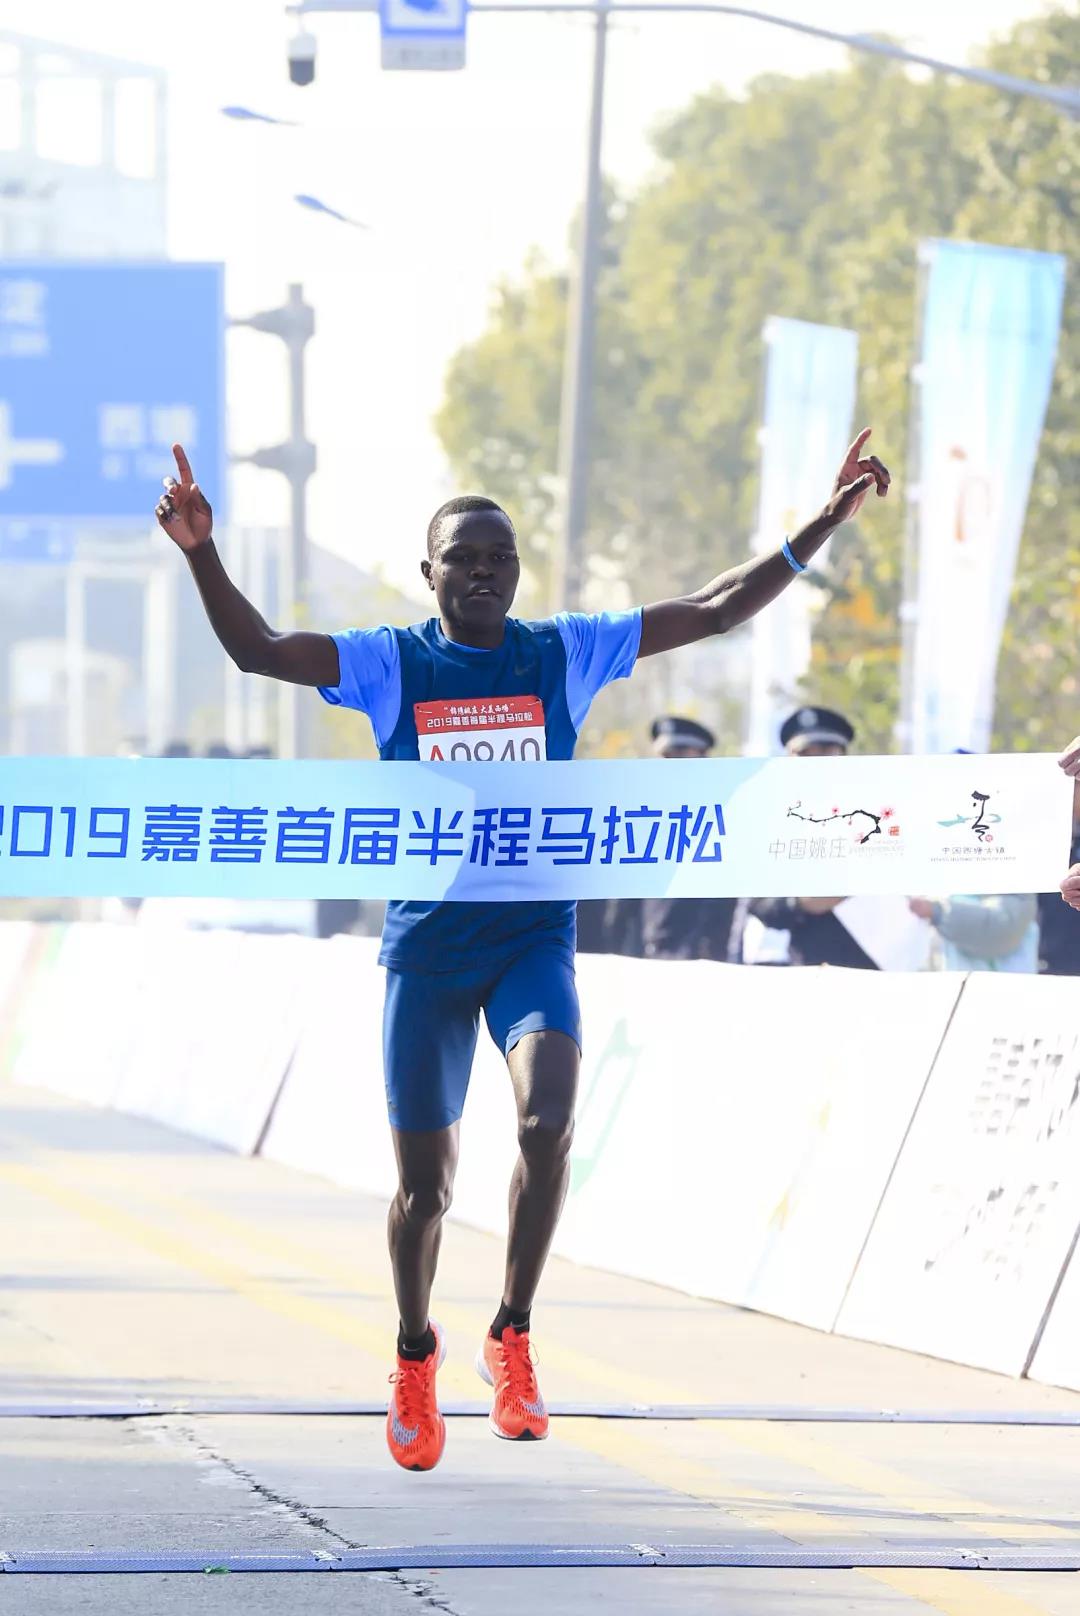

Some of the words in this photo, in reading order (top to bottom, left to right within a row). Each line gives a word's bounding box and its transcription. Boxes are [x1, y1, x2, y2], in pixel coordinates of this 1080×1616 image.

[0, 804, 726, 866] 019嘉善首届半程马拉松
